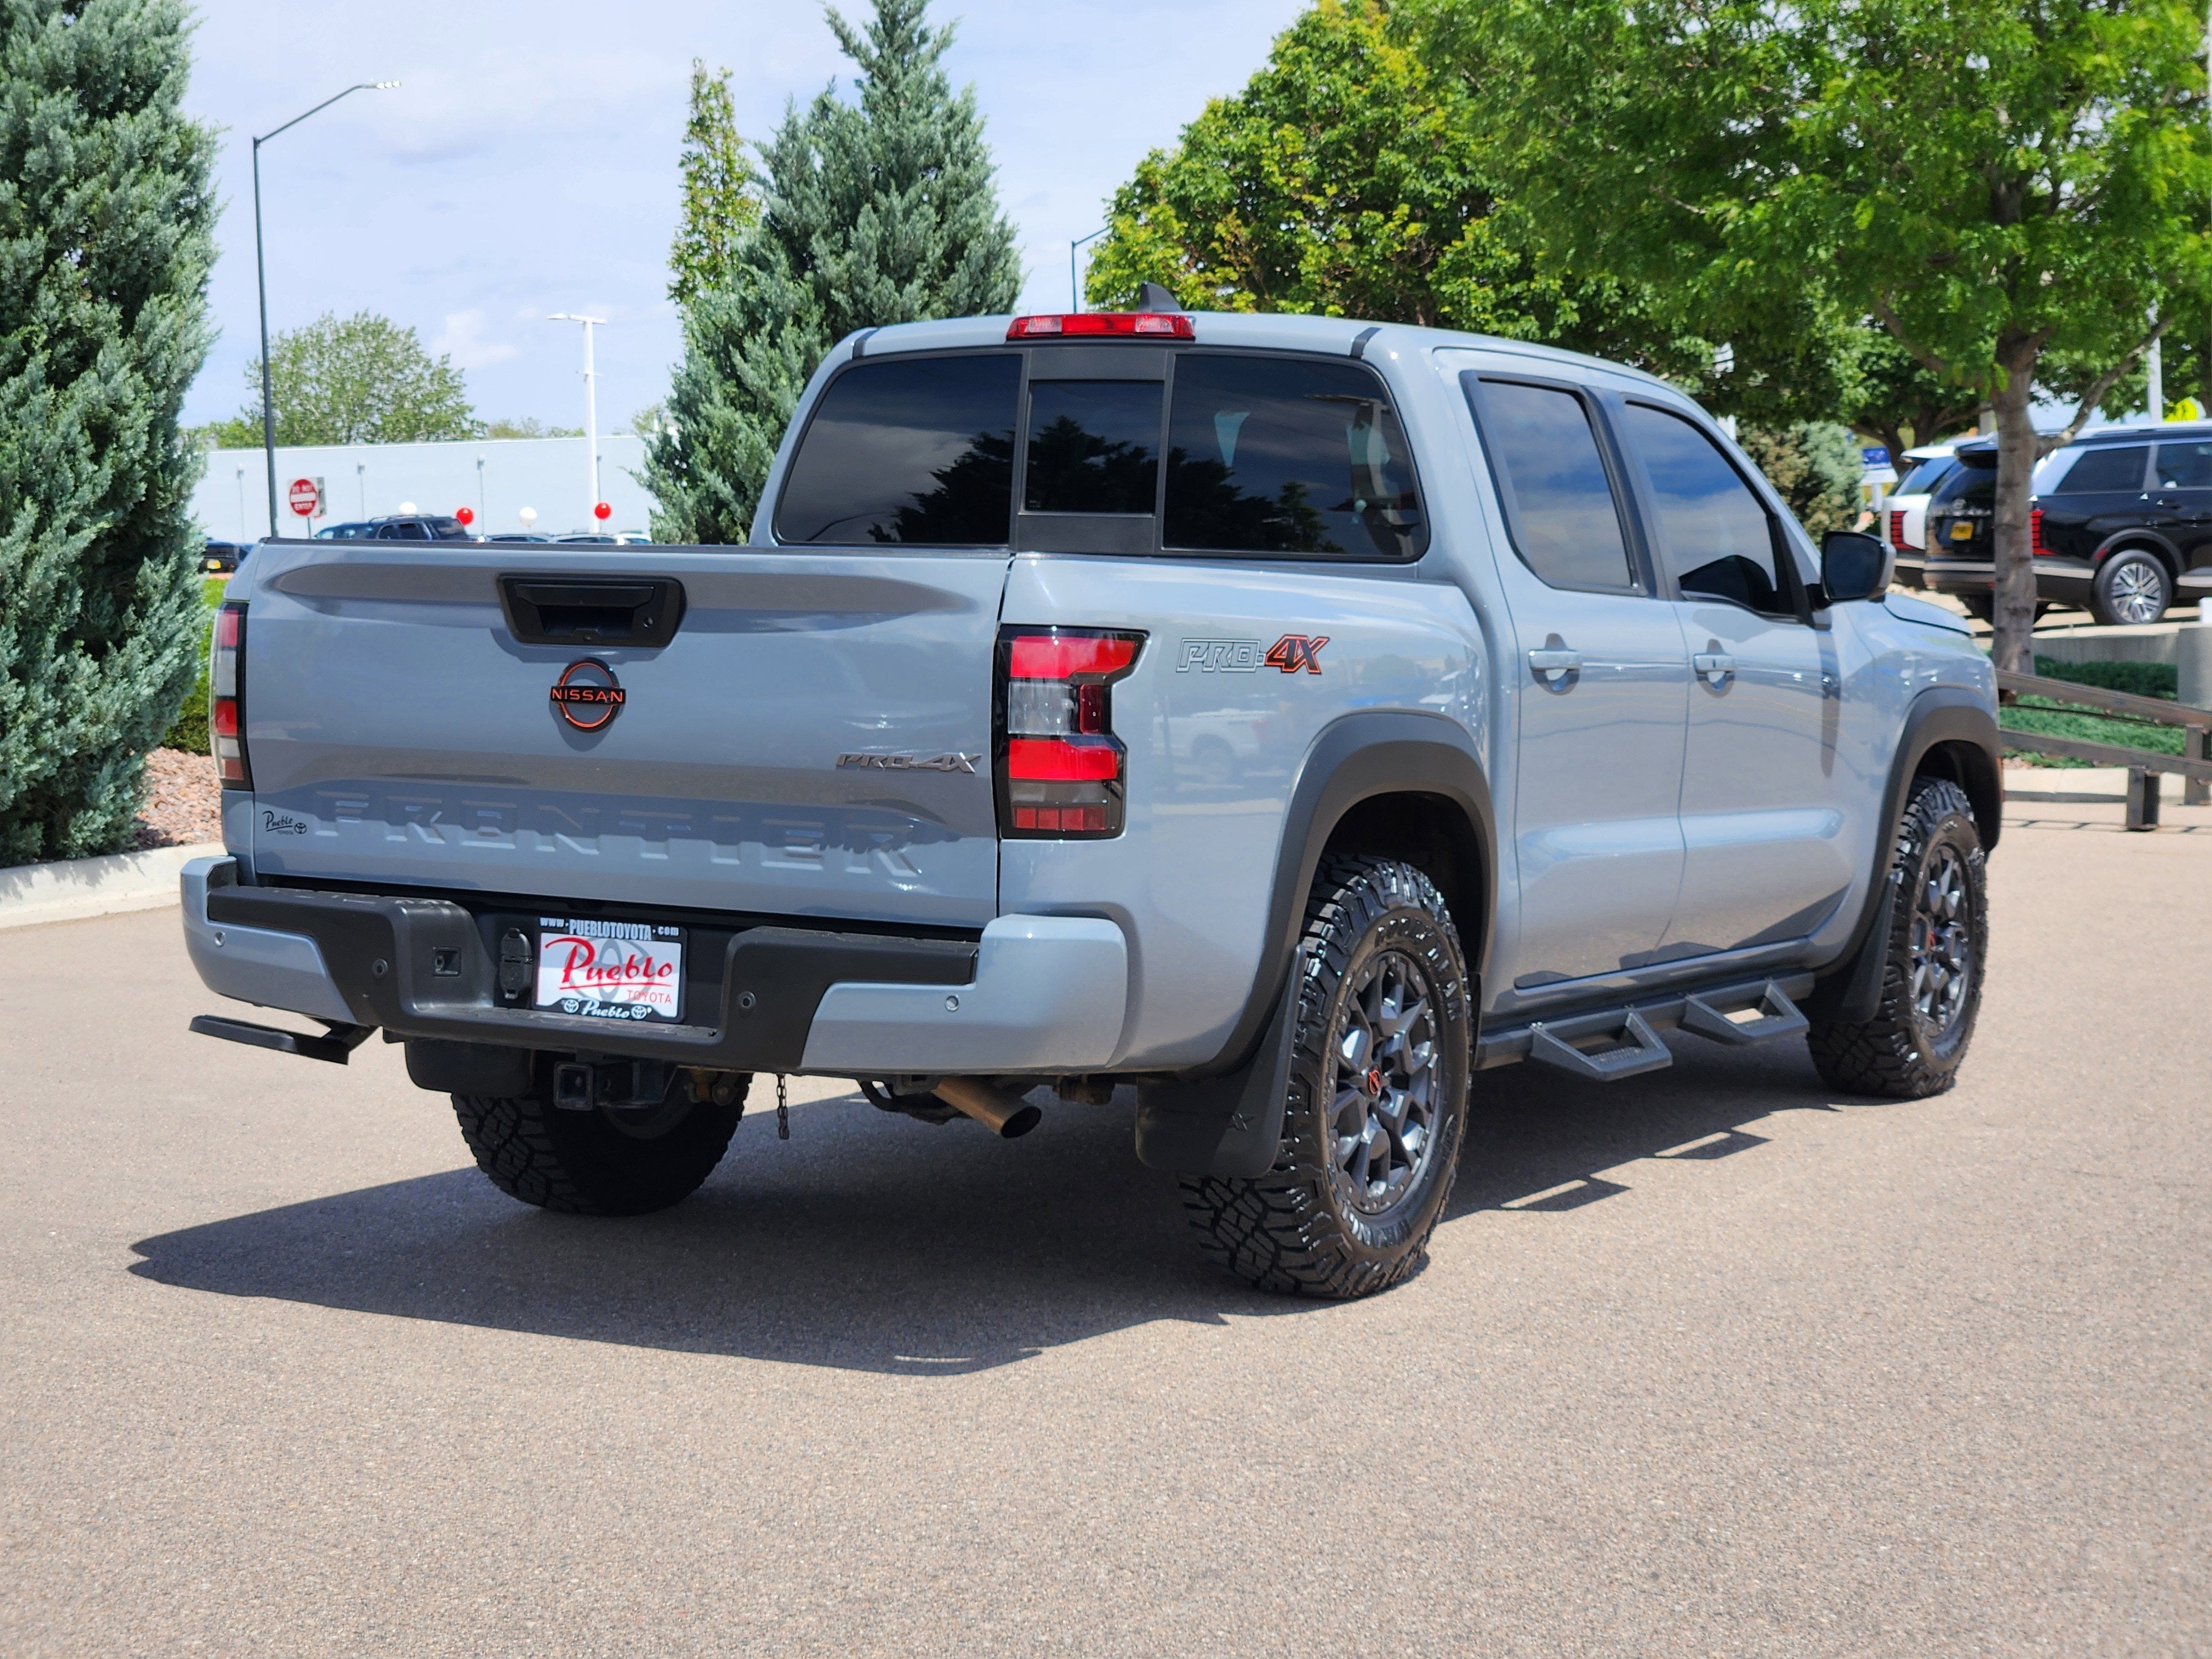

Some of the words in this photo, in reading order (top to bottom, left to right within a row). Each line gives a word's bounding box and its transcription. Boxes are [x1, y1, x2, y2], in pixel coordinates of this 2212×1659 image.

[1176, 634, 1331, 675] PRO-4X
[551, 688, 623, 703] NISSAN
[836, 752, 983, 773] PRO-4X
[313, 790, 924, 878] FRONTIER
[545, 937, 673, 984] Pueblo
[627, 989, 672, 1004] TOYOTA
[581, 999, 631, 1019] Pueblo
